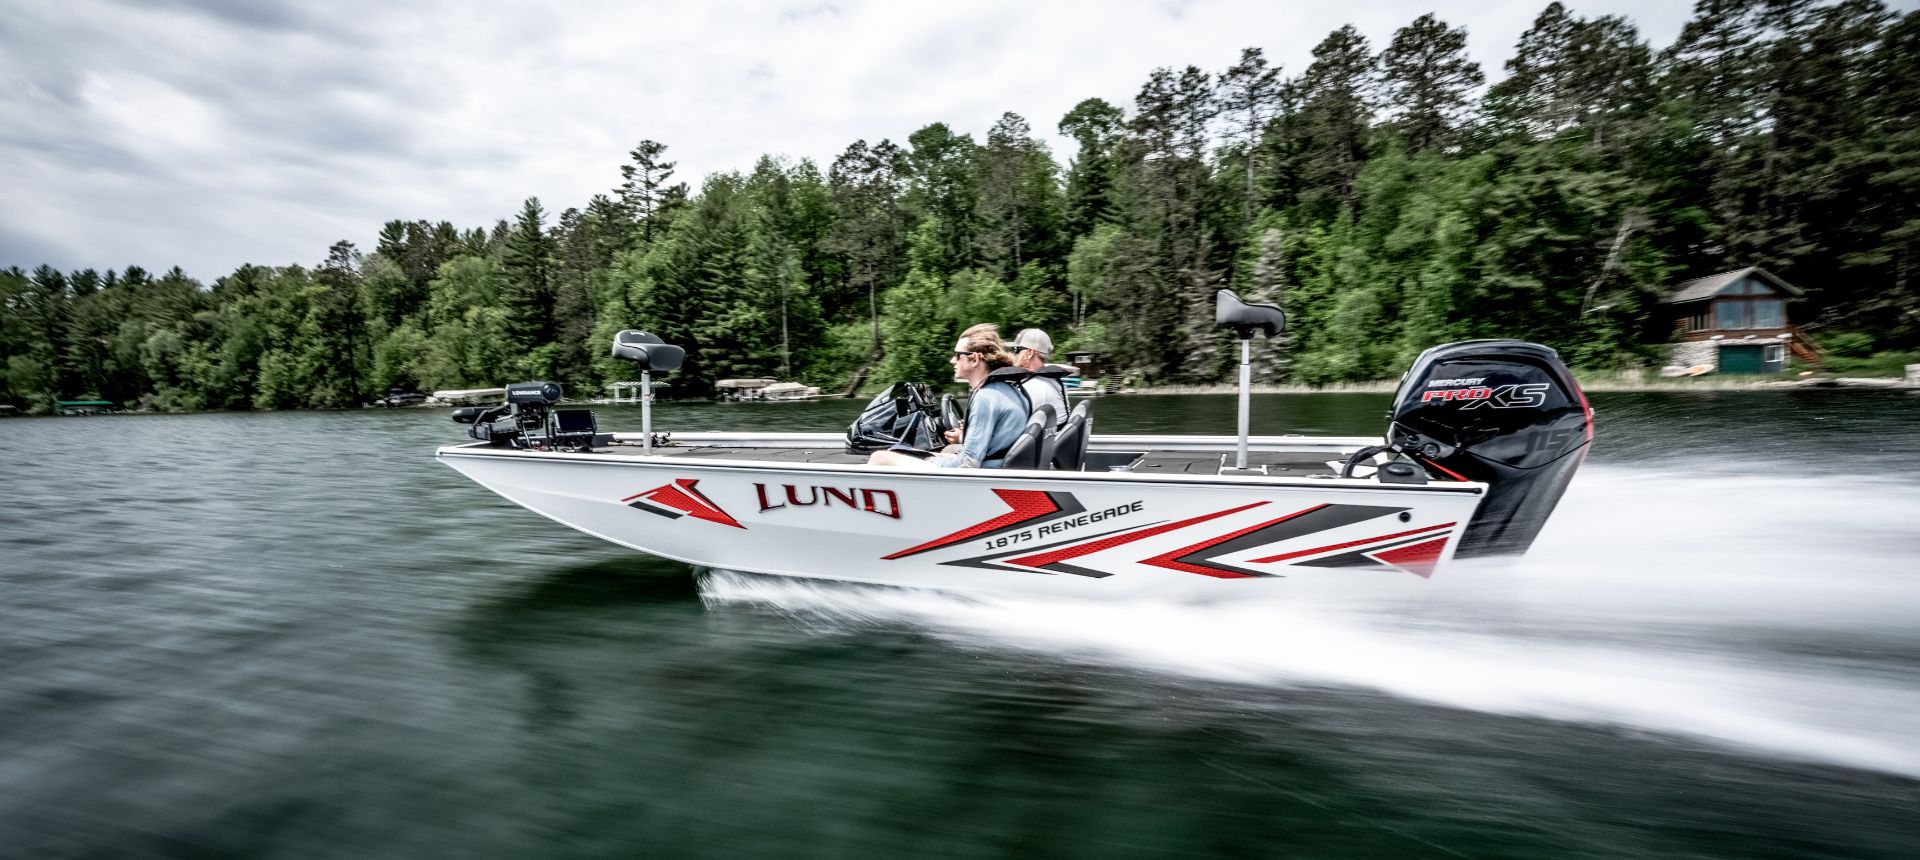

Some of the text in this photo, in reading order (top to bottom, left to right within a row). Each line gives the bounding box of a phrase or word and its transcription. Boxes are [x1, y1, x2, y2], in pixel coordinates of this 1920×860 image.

[1420, 382, 1551, 410] PRO XS
[1428, 378, 1486, 387] MERCURY
[753, 482, 901, 520] LUND
[985, 500, 1144, 551] 1875 RENEGADE
